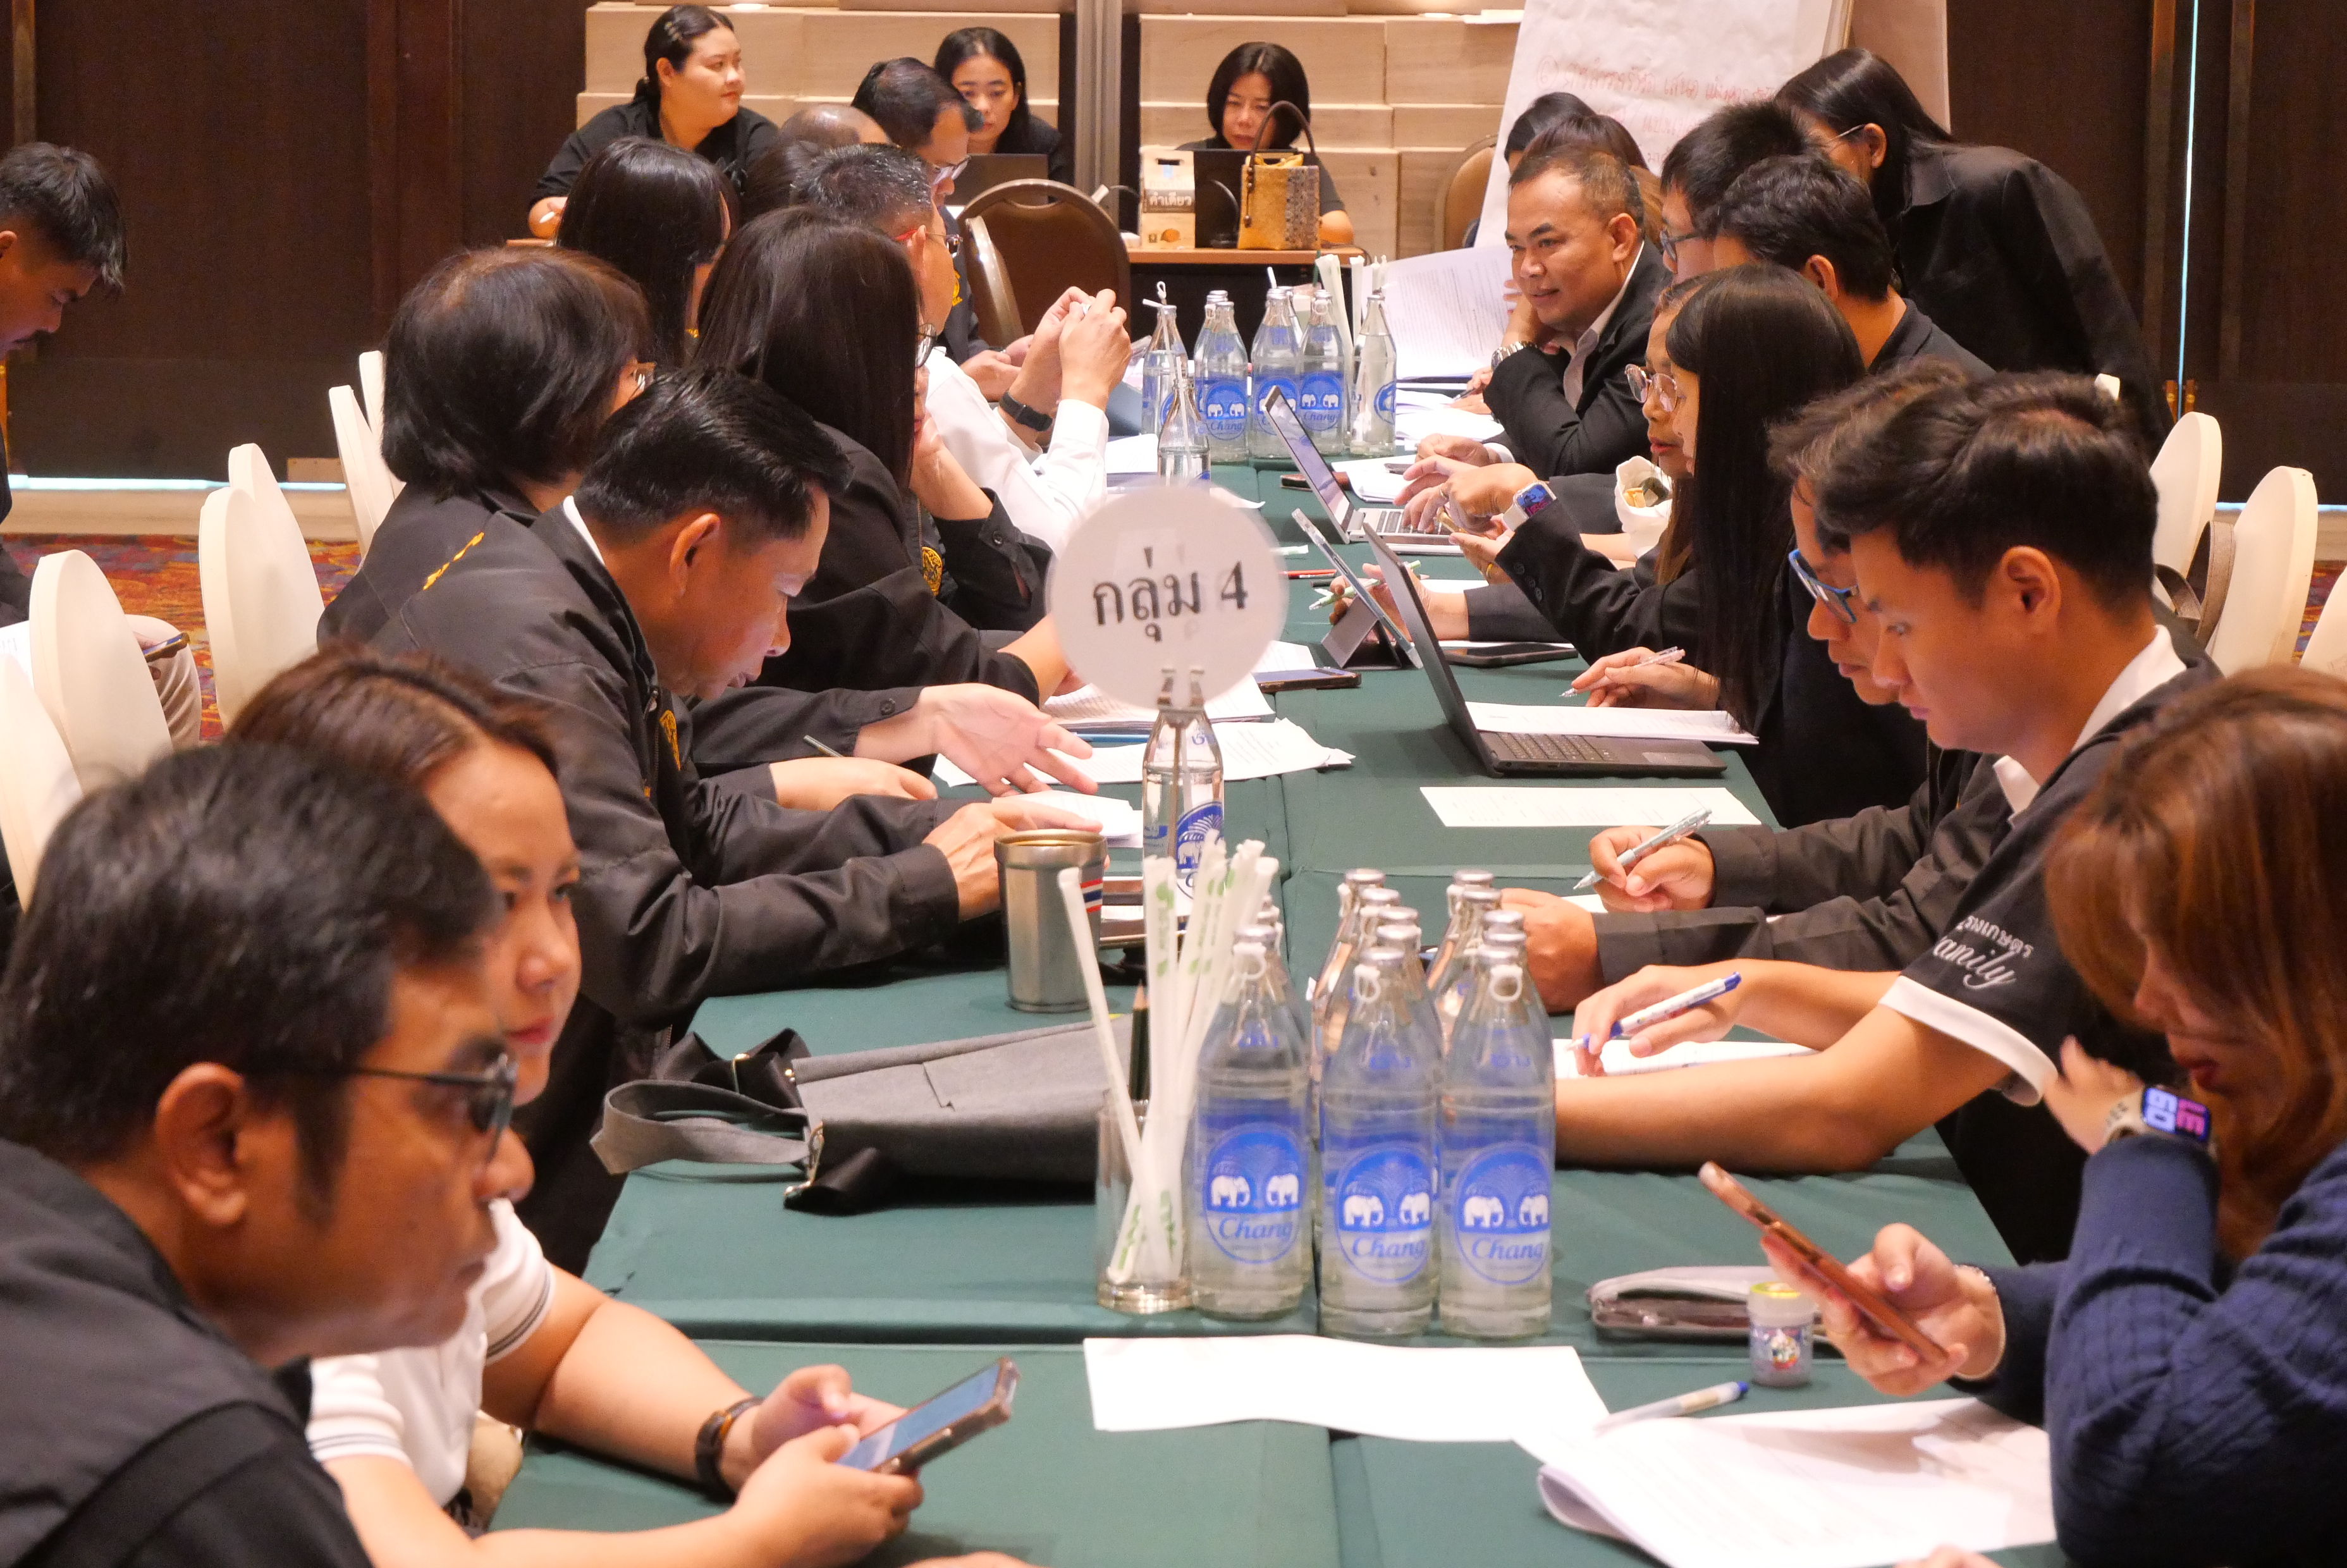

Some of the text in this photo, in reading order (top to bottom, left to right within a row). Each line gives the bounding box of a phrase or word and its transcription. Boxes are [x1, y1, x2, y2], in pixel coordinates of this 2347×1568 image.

[1092, 546, 1249, 642] กลุ่ม 4
[1932, 935, 2019, 990] amily
[1218, 1216, 1294, 1242] Chang
[1351, 1236, 1426, 1261] Chang
[1471, 1236, 1545, 1262] Chang
